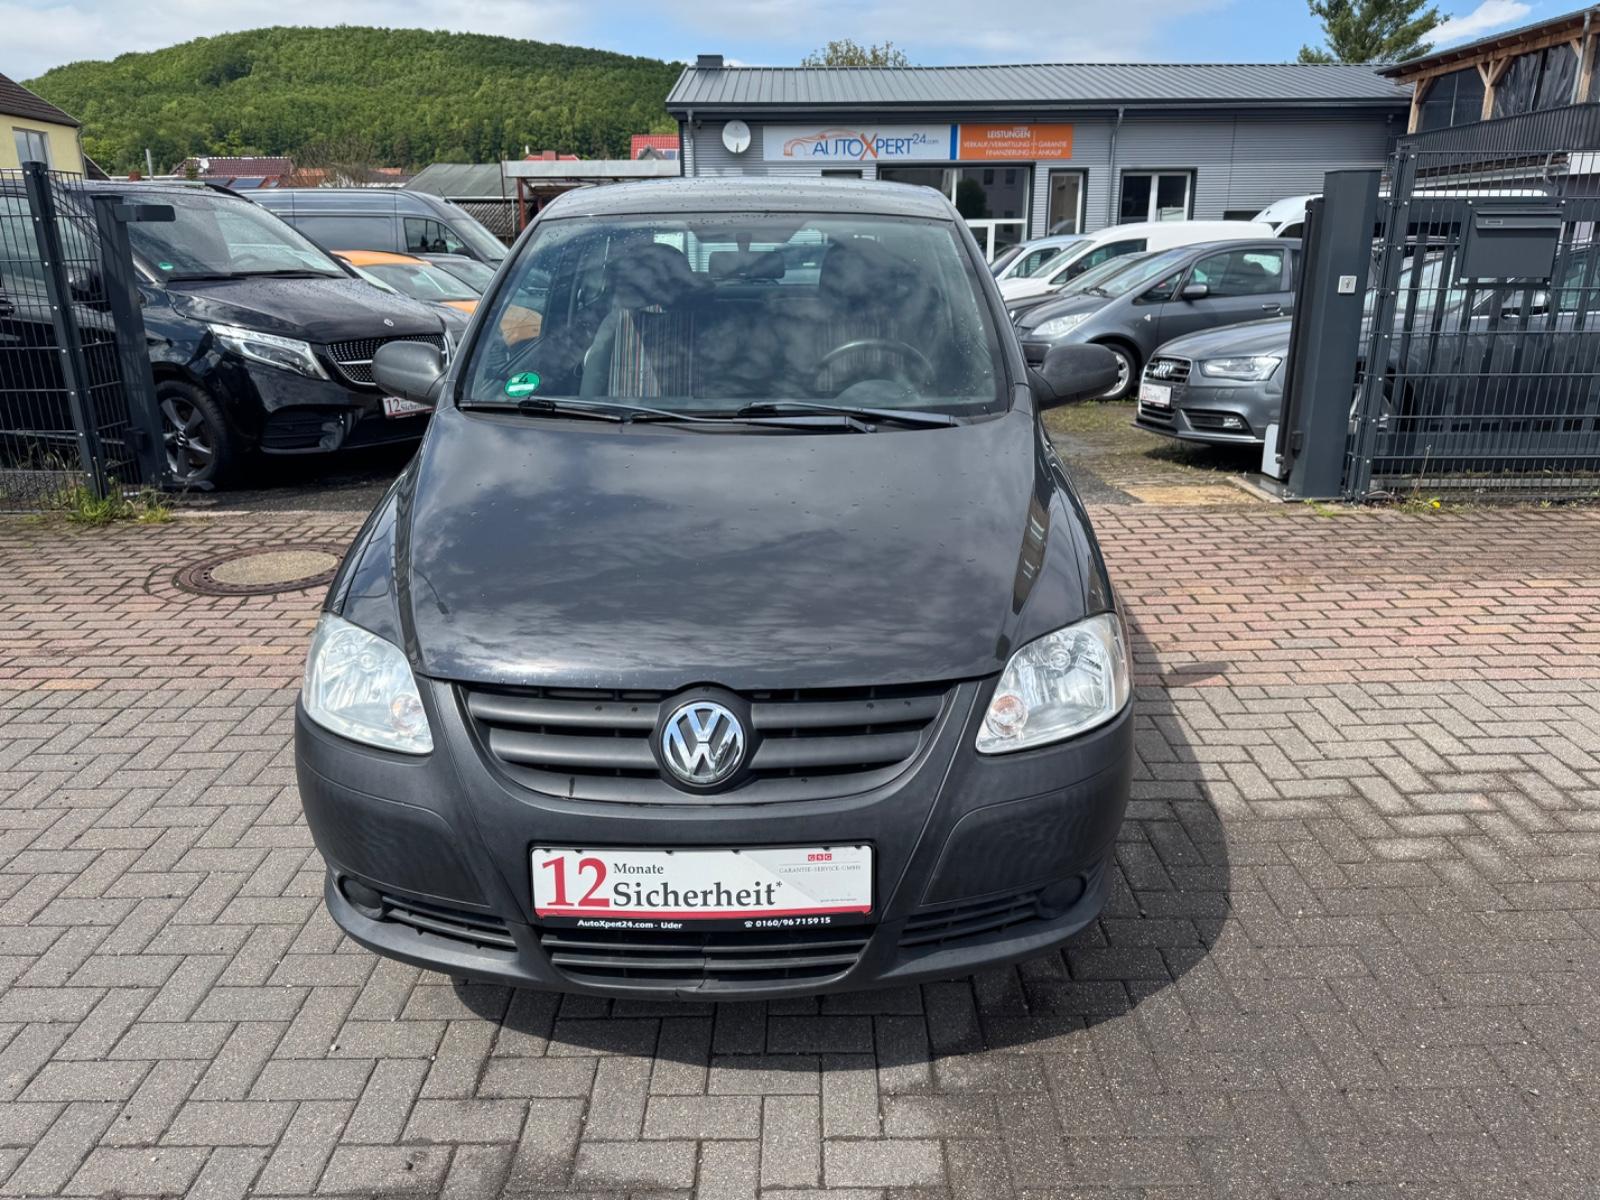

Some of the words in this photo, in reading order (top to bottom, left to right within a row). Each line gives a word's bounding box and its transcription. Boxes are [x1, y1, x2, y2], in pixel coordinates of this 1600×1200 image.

[987, 130, 1031, 138] LEISTUNGEN
[518, 372, 529, 385] 4
[613, 863, 664, 875] Monate
[542, 856, 610, 908] 12
